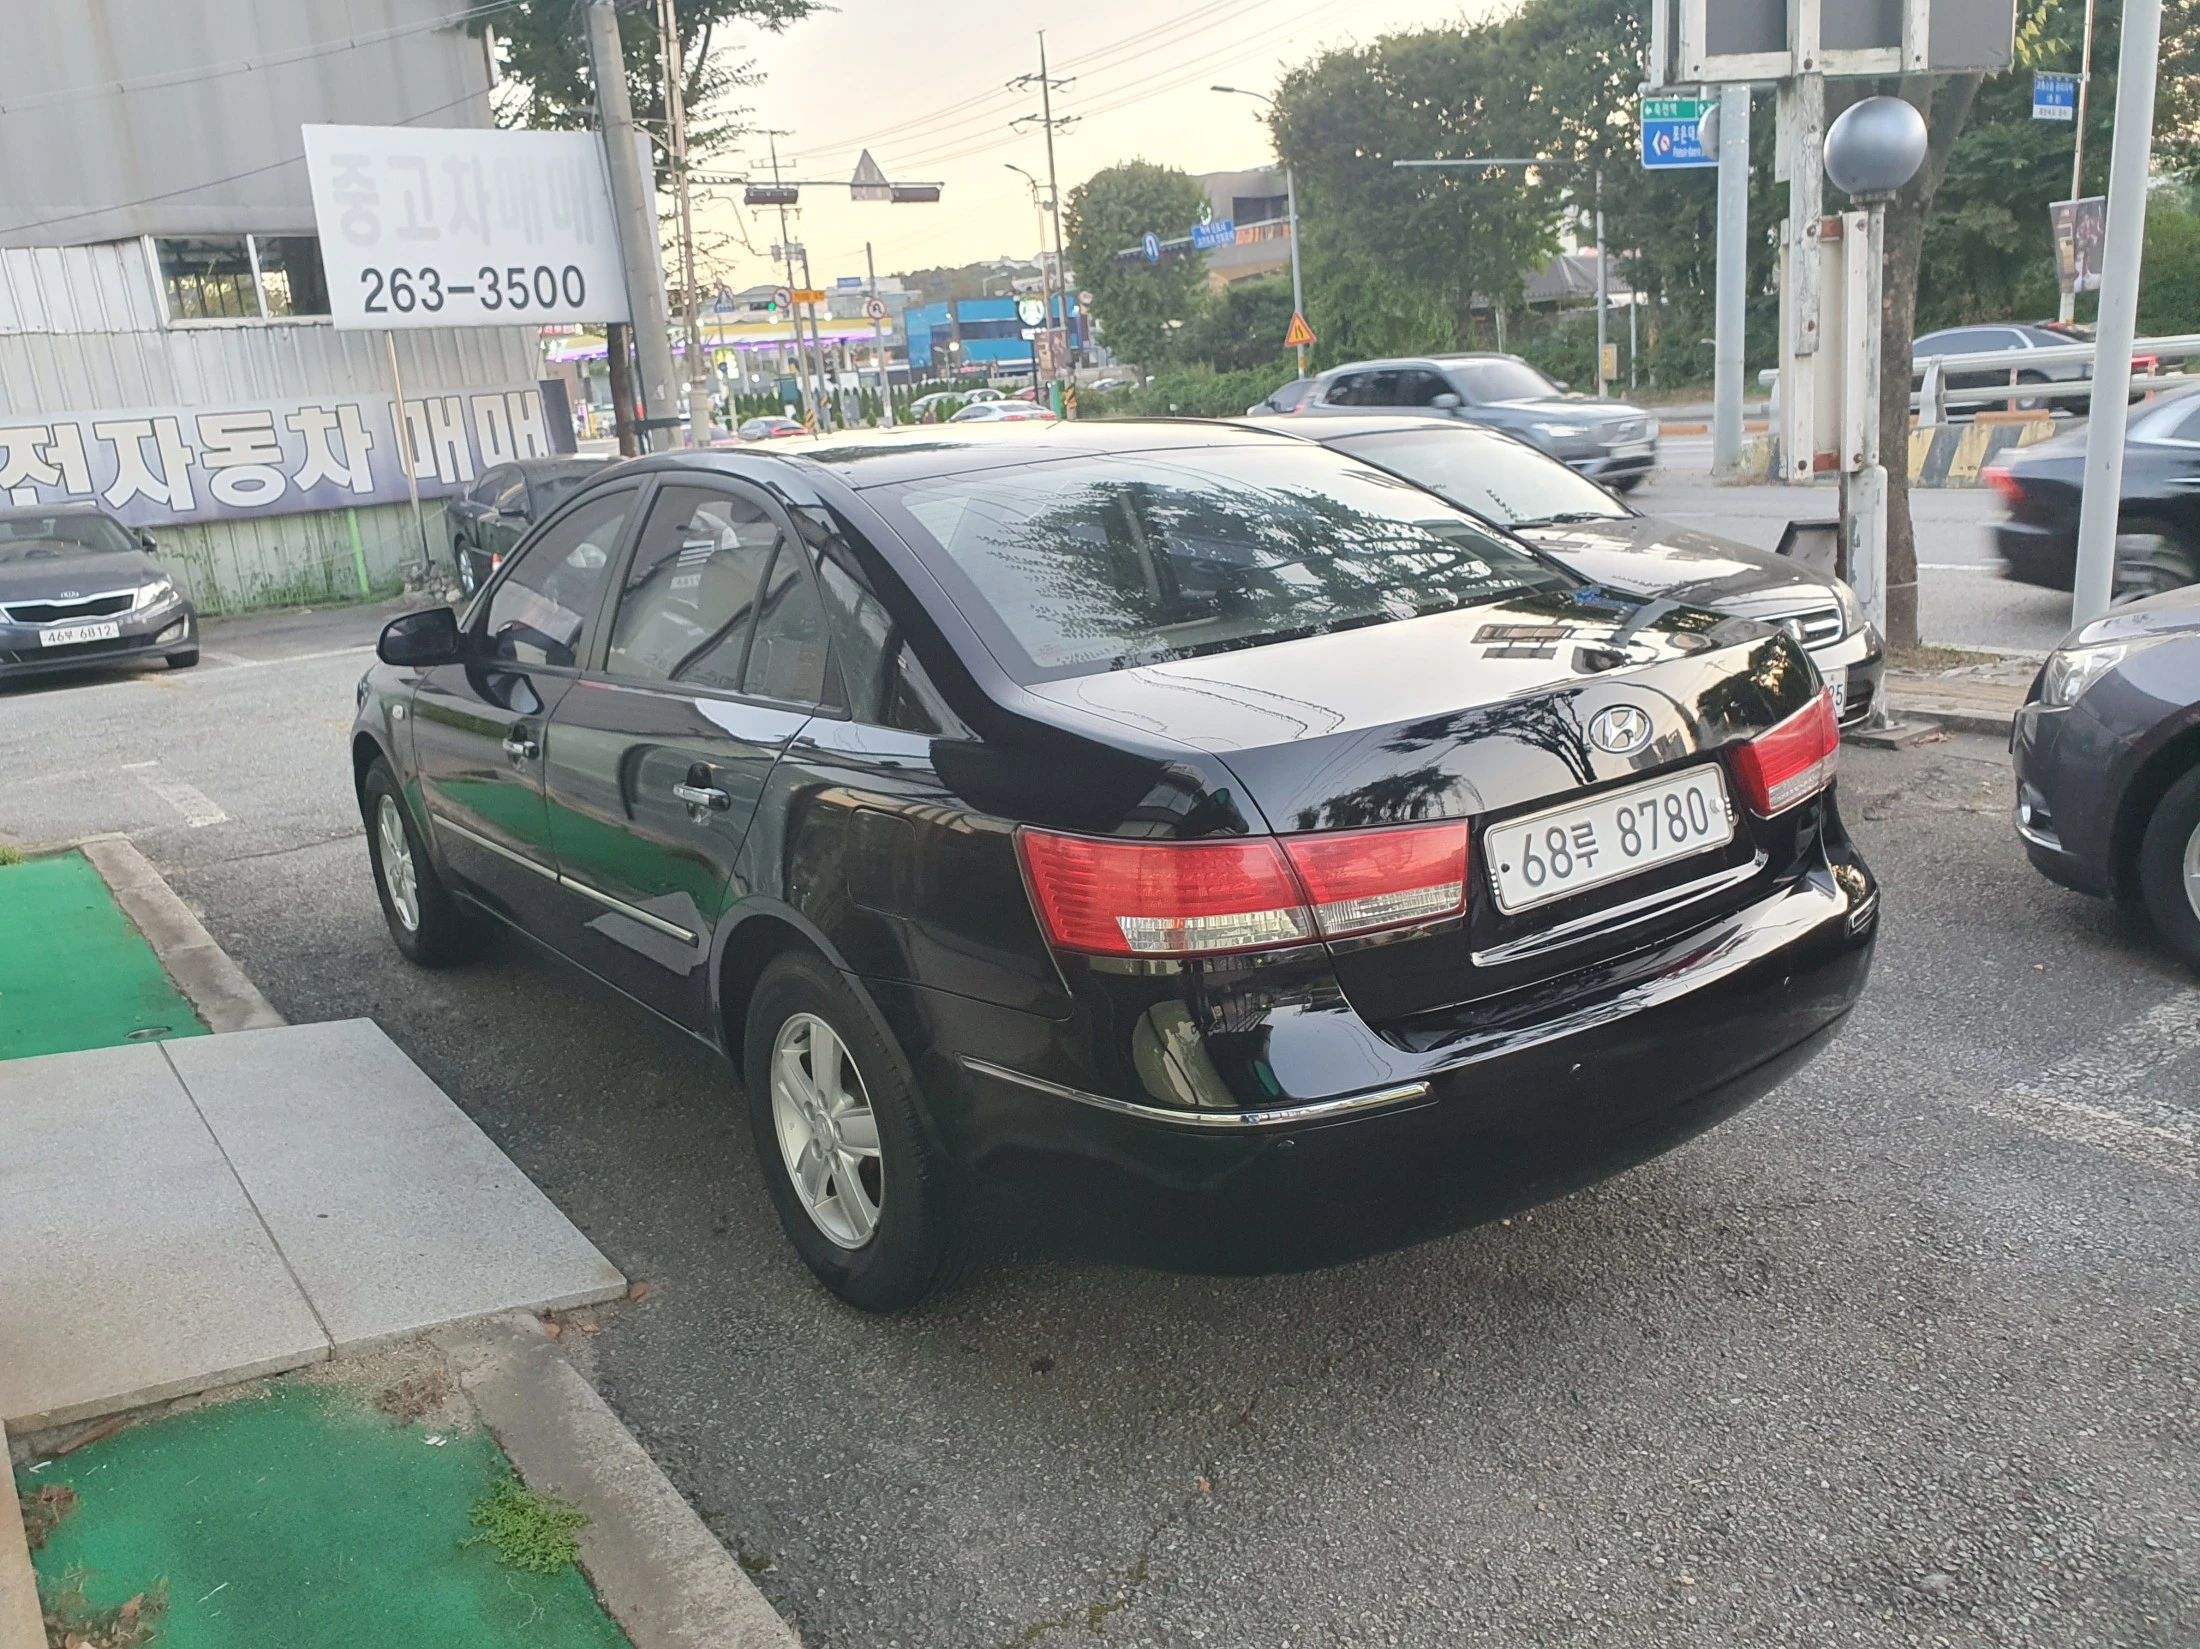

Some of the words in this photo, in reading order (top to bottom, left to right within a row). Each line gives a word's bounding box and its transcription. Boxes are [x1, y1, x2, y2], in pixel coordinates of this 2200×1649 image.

[330, 153, 595, 247] 중고차매매
[360, 265, 586, 313] 263-3500
[0, 403, 374, 512] 전자동차
[388, 389, 550, 485] 매매
[80, 625, 112, 639] 6812
[1521, 820, 1600, 888] 68루
[1616, 786, 1710, 858] 8780
